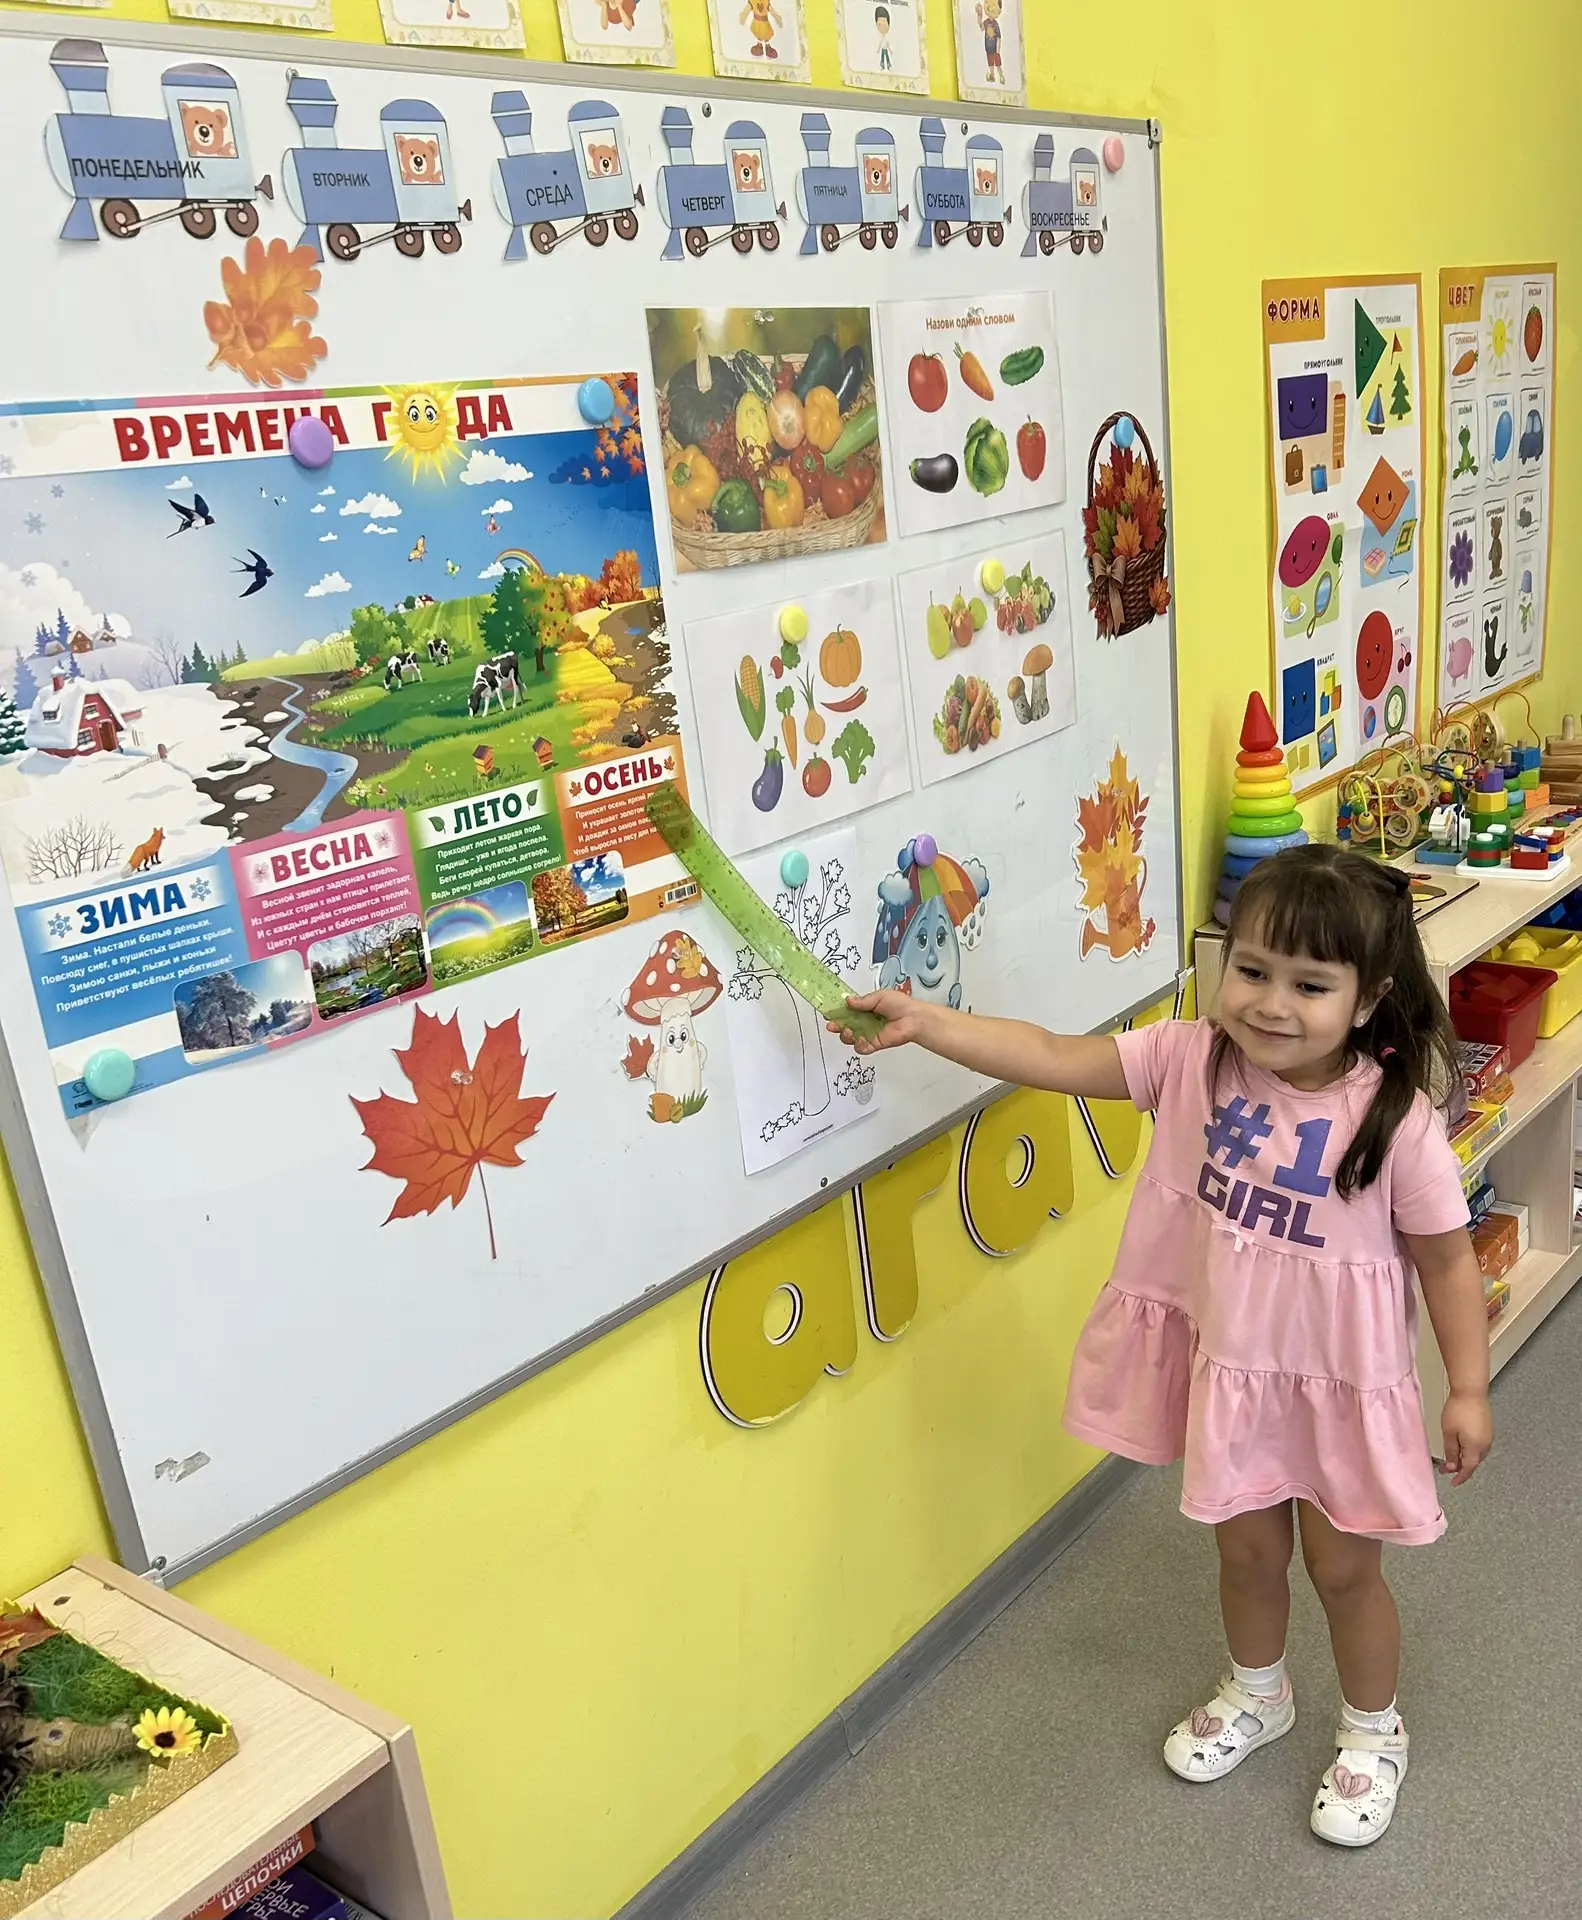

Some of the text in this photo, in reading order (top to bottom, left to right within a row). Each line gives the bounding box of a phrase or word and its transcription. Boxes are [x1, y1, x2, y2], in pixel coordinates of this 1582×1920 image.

[72, 158, 205, 181] ПОНЕДЕЛЬНИК
[313, 172, 371, 187] ВТОРНИК
[526, 184, 574, 207] СРЕДА
[681, 196, 726, 212] ЧЕТВЕРГ
[813, 185, 848, 197] ПЯТНИЦА
[926, 193, 966, 209] СУББОТА
[1031, 212, 1090, 227] ВОСКРЕСЕНЬЕ
[1267, 298, 1320, 322] ФОРМА
[1448, 285, 1475, 308] ЦВЕТ
[925, 314, 1015, 331] Назови одним словом
[1303, 357, 1344, 370] ПРЯМОУГОЛЬНИК
[584, 756, 663, 796] ОСЕНЬ
[453, 792, 522, 834] ЛЕТО
[575, 805, 607, 820] Приносит
[607, 800, 627, 810] осень
[627, 793, 646, 805] яркий
[585, 829, 609, 842] дождик
[618, 821, 638, 831] окном
[589, 815, 619, 829] украшает
[437, 843, 474, 859] Приходит
[475, 836, 497, 849] летом
[498, 830, 523, 843] жаркая
[623, 833, 637, 843] лесу
[270, 832, 374, 883] ВЕСНА
[435, 857, 469, 873] Глядишь
[475, 852, 490, 863] уже
[497, 844, 518, 855] ягода
[518, 834, 549, 848] поспела.
[431, 854, 562, 900] Ведь речку щедро солнышко согрело!
[439, 873, 457, 885] Беги
[458, 866, 484, 879] скорей
[484, 858, 519, 874] купаться,
[250, 916, 263, 927] Из
[263, 909, 294, 925] южных
[295, 901, 319, 916] стран
[326, 894, 342, 905] нам
[342, 887, 369, 901] птицы
[369, 873, 413, 892] прилетают.
[261, 865, 399, 910] Весной звенит задорная капель,
[76, 882, 187, 935] ЗИМА
[256, 929, 265, 939] И
[273, 919, 309, 935] каждым
[310, 910, 333, 925] днём
[333, 899, 381, 918] становится
[381, 888, 412, 903] теплей,
[266, 935, 298, 951] Цветут
[299, 927, 327, 941] цветы
[335, 914, 370, 930] бабочки
[370, 901, 408, 920] порхают!
[41, 966, 86, 986] Повсюду
[87, 960, 111, 973] снег,
[119, 944, 168, 966] пушистых
[168, 936, 202, 952] шапках
[203, 926, 235, 942] крыши.
[60, 918, 213, 965] Зима. Настали белые деньки.
[56, 953, 234, 1013] Приветствуют весёлых ребятишек!
[69, 976, 106, 994] Зимою
[107, 968, 141, 983] санки,
[141, 958, 171, 972] лыжи
[181, 945, 217, 962] коньки
[1197, 1161, 1326, 1248] GIRL
[221, 1840, 304, 1912] ЦЕПОЧКИ
[239, 1899, 277, 1920] ГРЫ
[252, 1888, 310, 1918] ЕРВЫЕ
